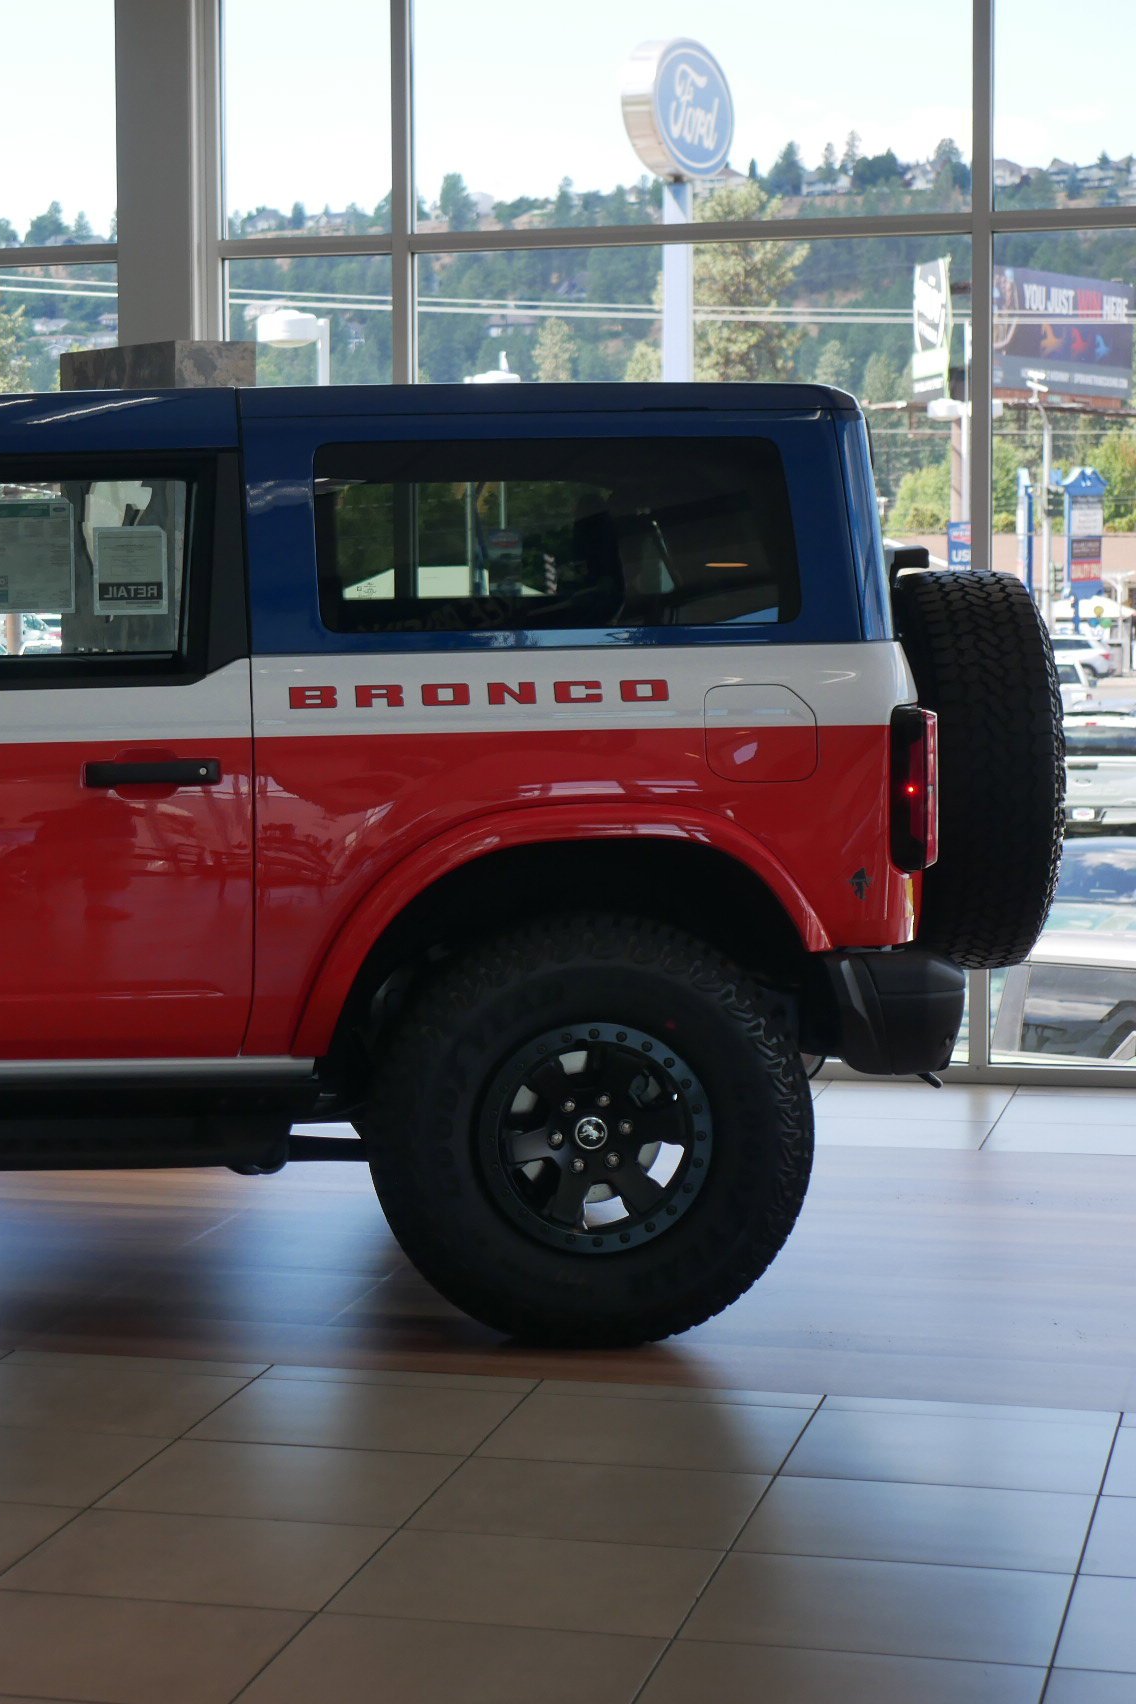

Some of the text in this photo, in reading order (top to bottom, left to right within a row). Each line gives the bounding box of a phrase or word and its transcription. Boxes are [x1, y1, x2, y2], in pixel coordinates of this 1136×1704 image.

[670, 63, 720, 151] Ford
[1023, 283, 1047, 311] YOU
[1047, 287, 1075, 315] JUST
[1103, 295, 1128, 323] HERE
[952, 550, 971, 562] US
[288, 679, 669, 709] BRONCO
